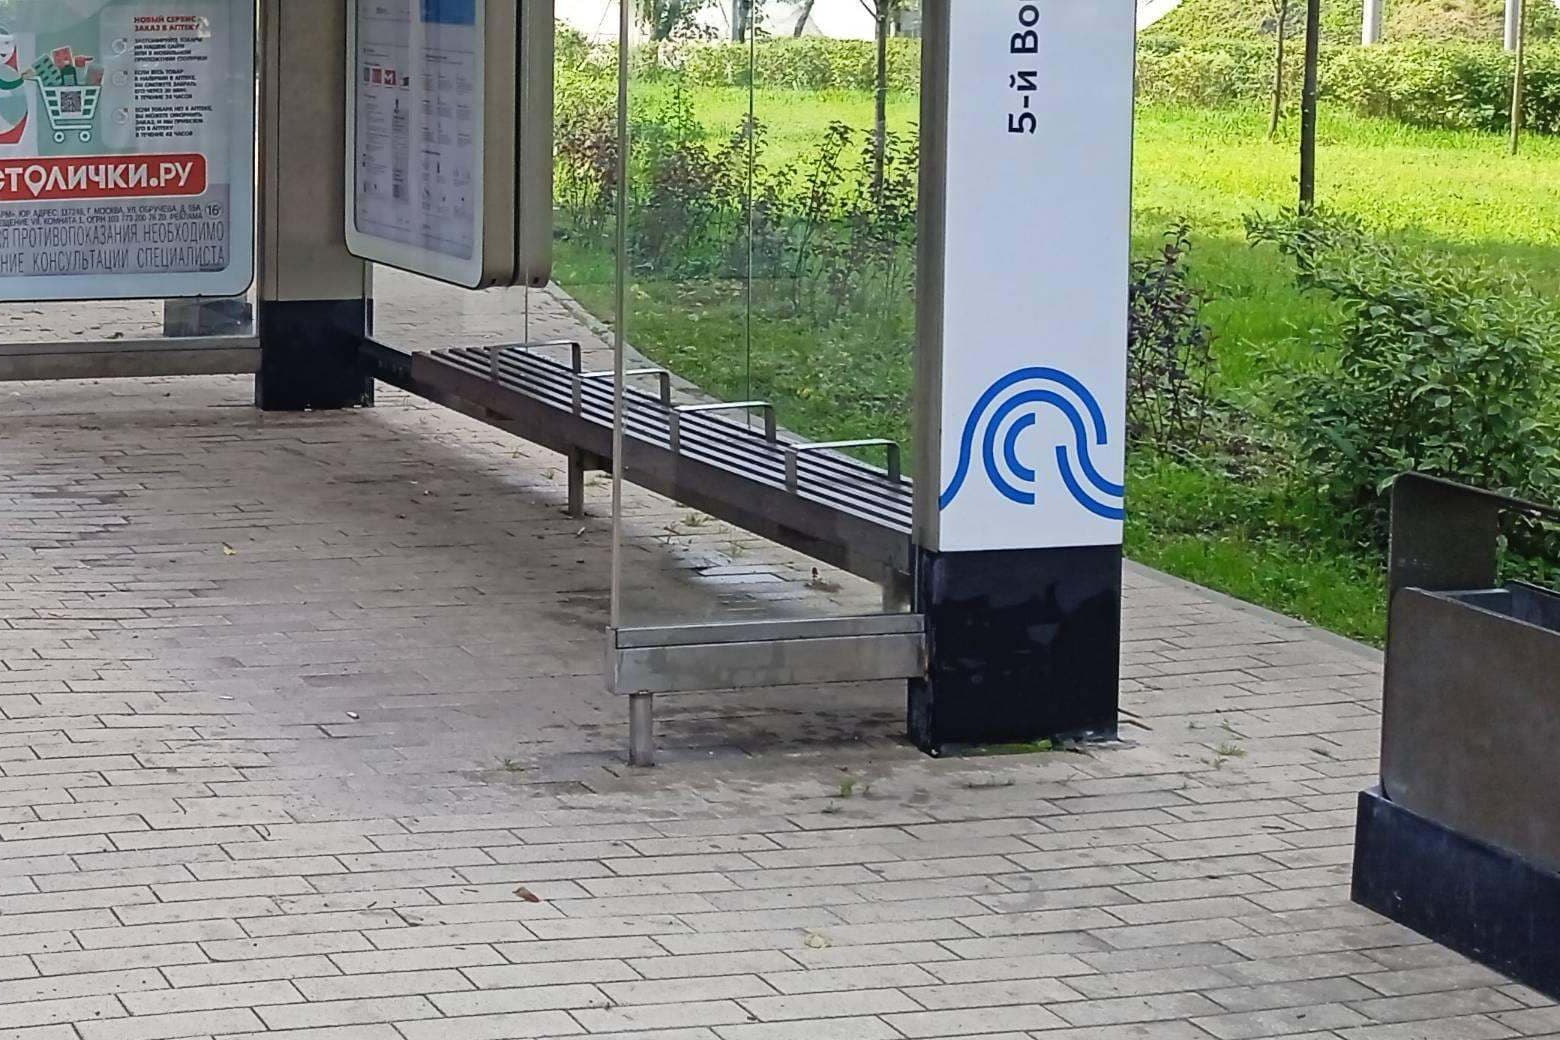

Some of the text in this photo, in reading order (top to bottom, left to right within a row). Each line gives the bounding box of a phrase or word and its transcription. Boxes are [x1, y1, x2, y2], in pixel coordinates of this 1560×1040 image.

[134, 15, 164, 23] НОВЫЙ
[135, 24, 160, 32] ЗАКАЗ
[169, 23, 200, 31] АПТЕКУ
[1008, 69, 1038, 135] 5-й
[143, 220, 224, 244] НЕОБХОДИМО
[33, 249, 129, 273] КОНСУЛЬТАЦИИ
[137, 245, 225, 269] СПЕЦИАЛИСТА
